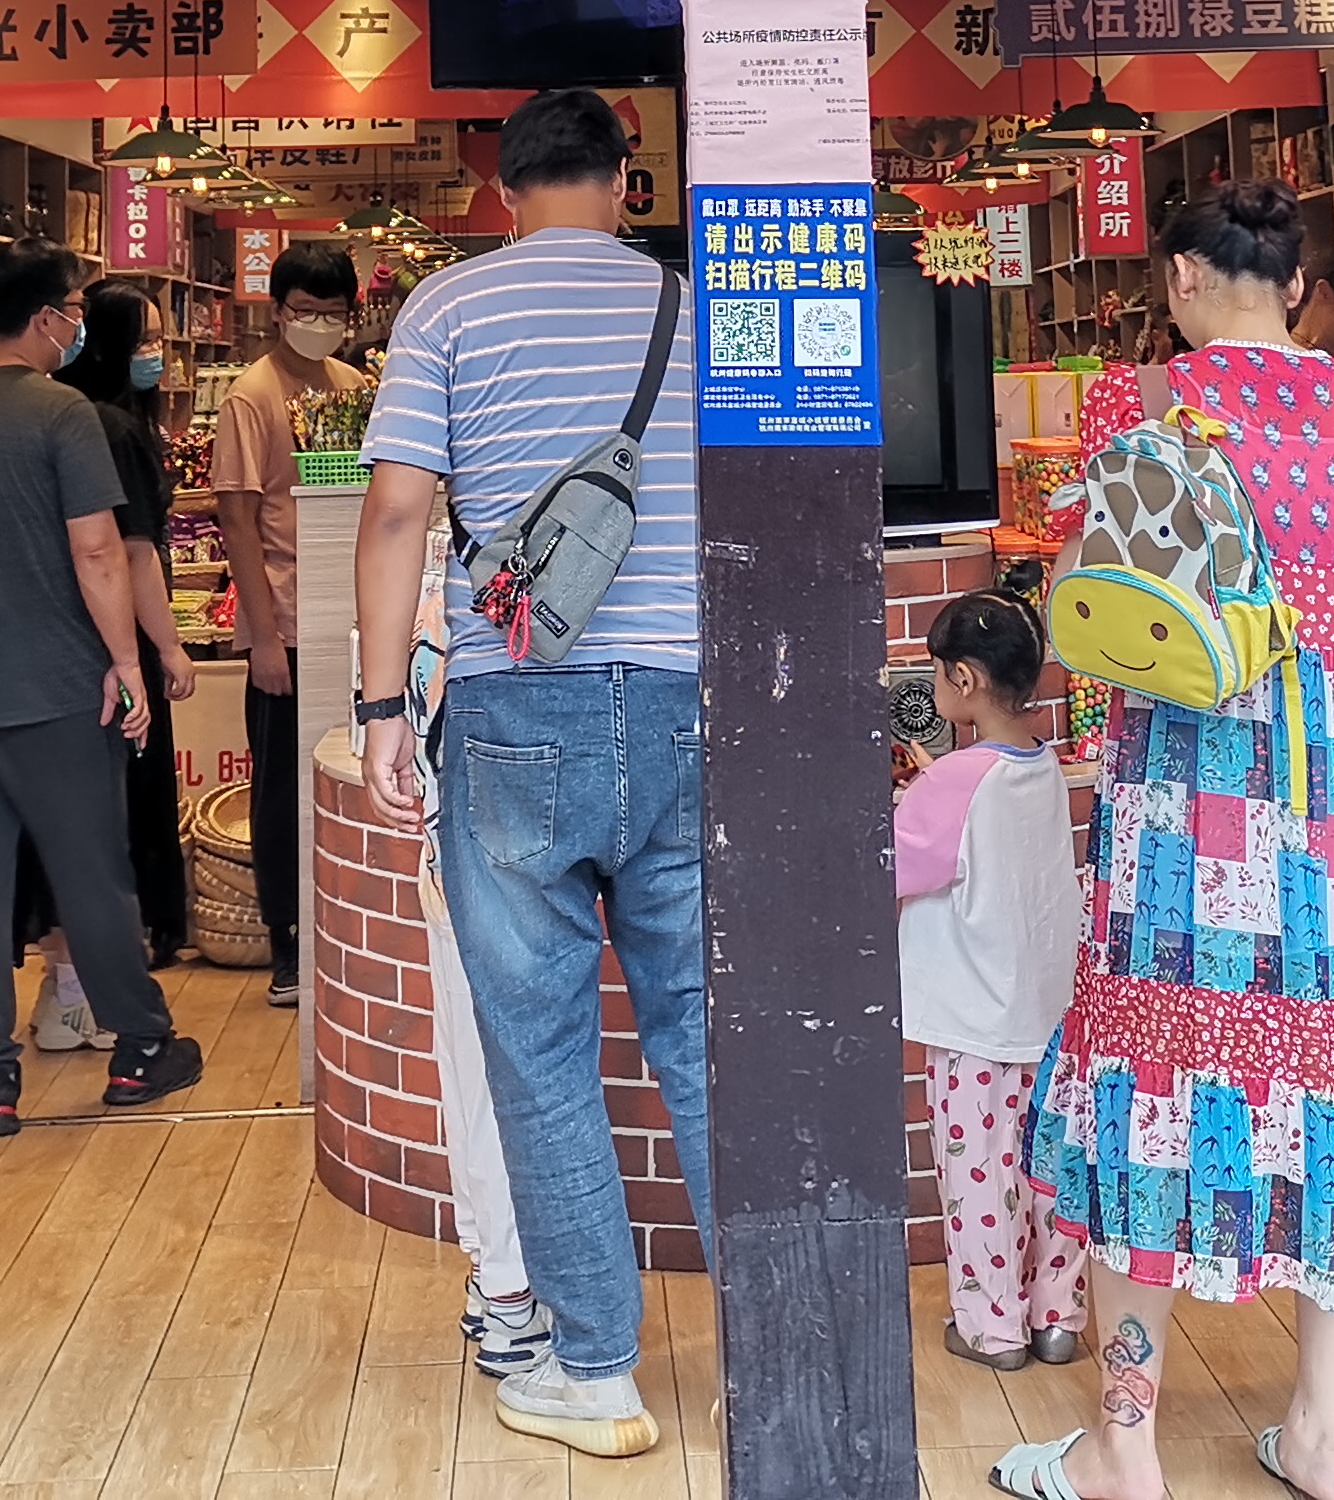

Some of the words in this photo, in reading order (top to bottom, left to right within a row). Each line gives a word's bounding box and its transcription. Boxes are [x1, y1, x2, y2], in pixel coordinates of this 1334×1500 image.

[336, 6, 390, 59] 产
[1095, 137, 1132, 238] 介绍所
[744, 199, 782, 217] 远距离
[787, 199, 824, 217] 勤洗手
[829, 198, 867, 217] 不聚集
[704, 222, 866, 255] 请出示健康码
[705, 259, 867, 291] 扫描行程二维码
